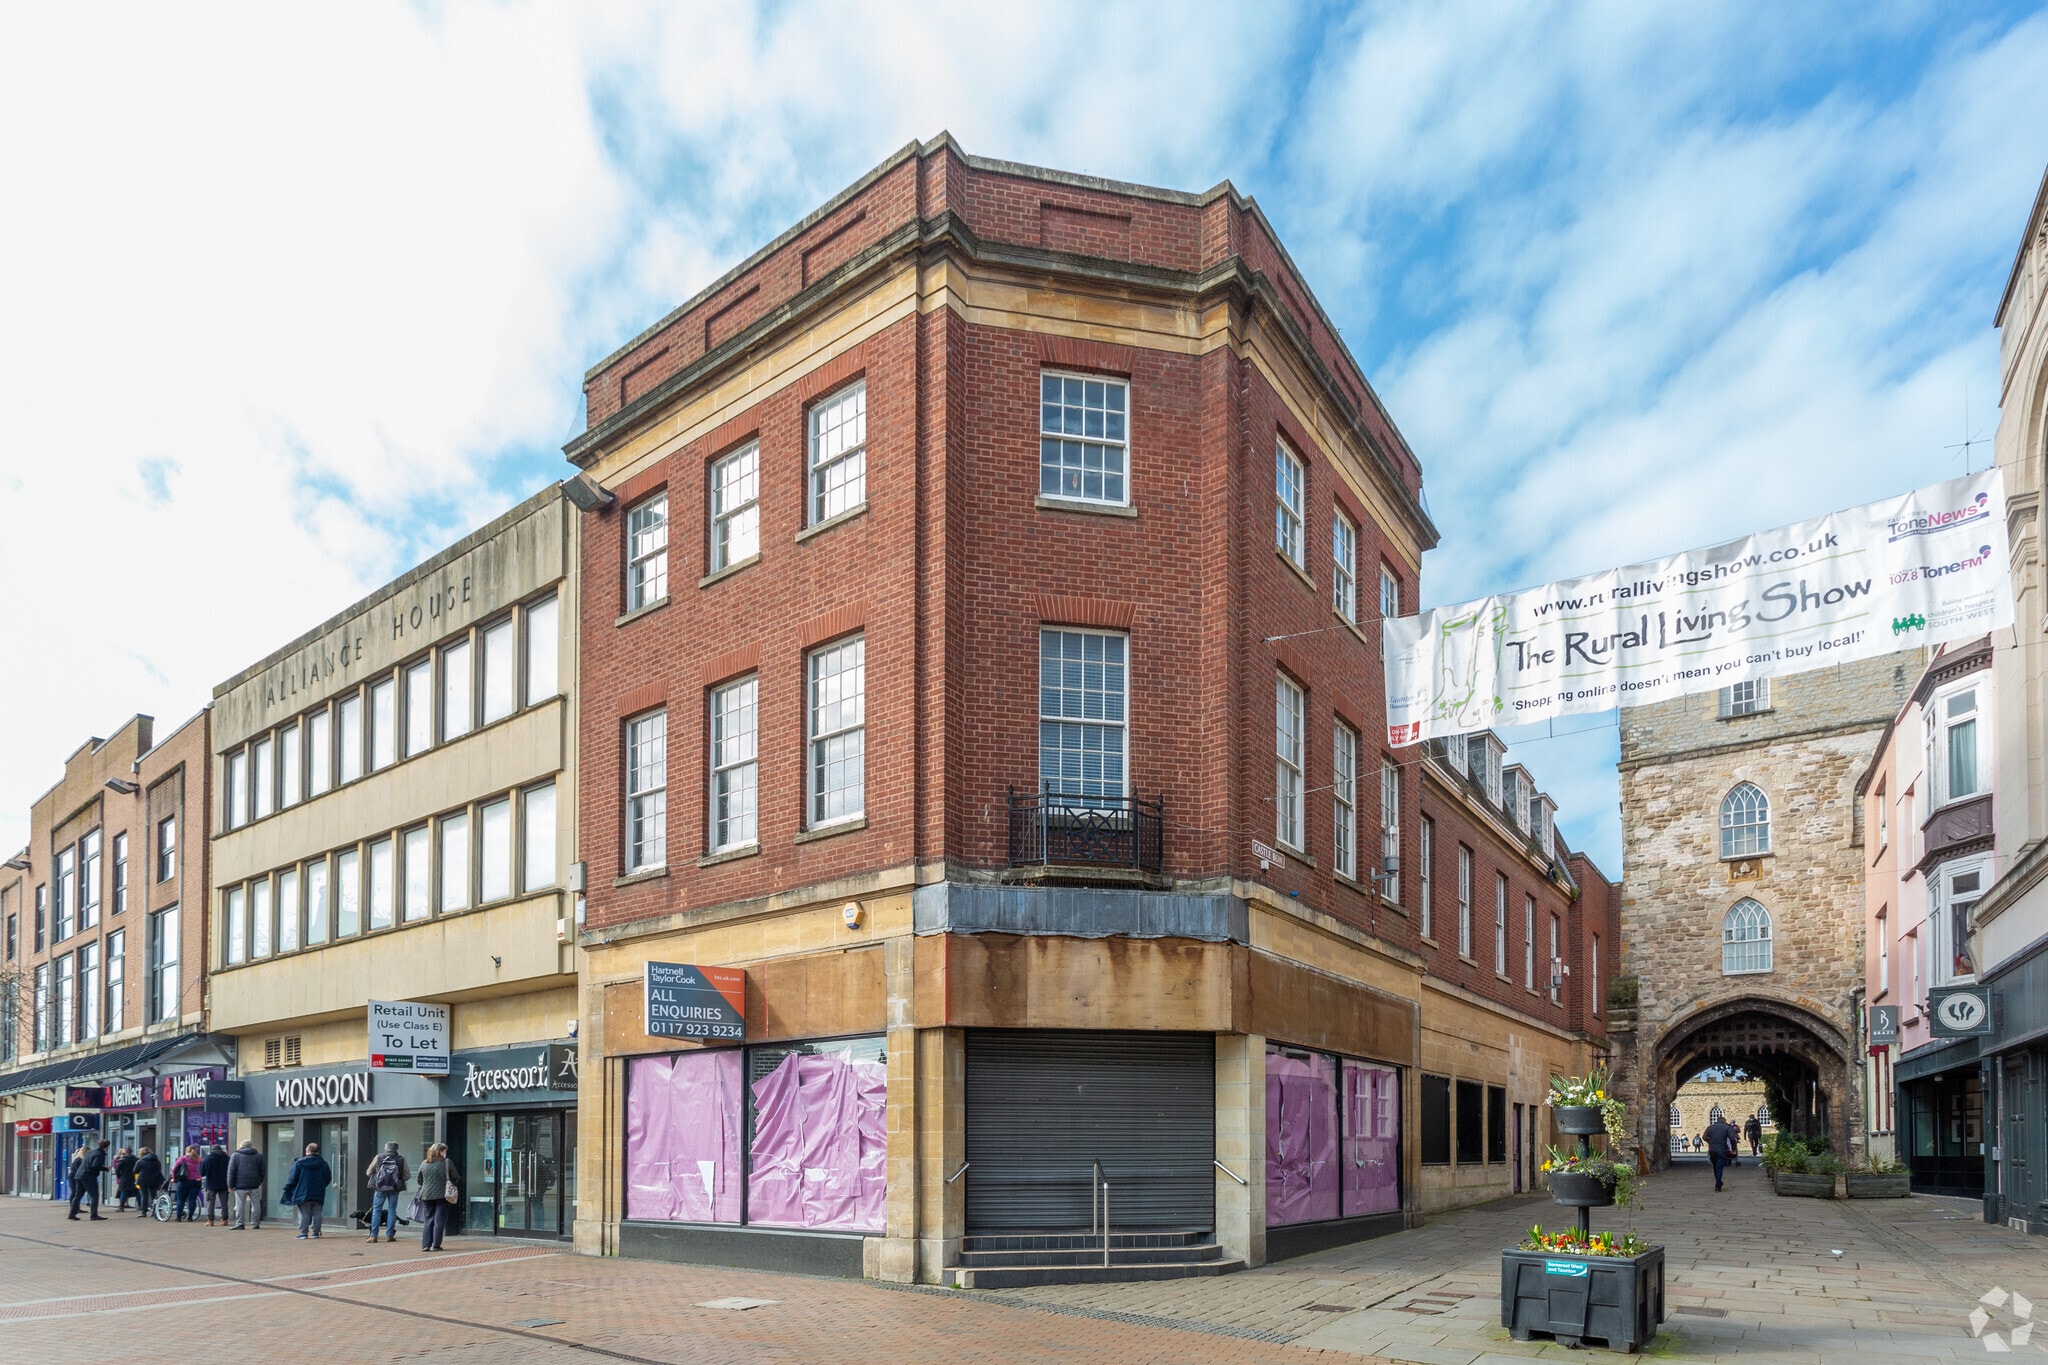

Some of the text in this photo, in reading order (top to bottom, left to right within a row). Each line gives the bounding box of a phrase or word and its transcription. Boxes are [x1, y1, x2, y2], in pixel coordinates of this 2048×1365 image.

[1888, 505, 1977, 535] ToneNews
[1533, 533, 1839, 617] www.rurallivngshow.co.uk
[1890, 571, 1918, 585] 107.8
[1965, 598, 1995, 610] hospice
[1506, 579, 1872, 671] The Rural Living Show
[1928, 607, 1995, 629] SOUTH WEST
[266, 577, 471, 708] ALLIANCE HOUSE
[1512, 691, 1574, 710] 'Shoppng
[1577, 684, 1617, 699] online
[1673, 667, 1711, 681] mean
[1715, 659, 1742, 675] you
[1746, 651, 1781, 664] can't
[1786, 644, 1813, 658] buy
[1254, 843, 1271, 860] CASTLE
[651, 965, 683, 976] Hartnell
[651, 989, 677, 1002] ALL
[374, 1004, 445, 1018] Retail Unit
[651, 1004, 722, 1020] ENQUIRIES
[377, 1020, 443, 1032] (Use Class E)
[651, 1021, 742, 1037] 0117 923 9234
[382, 1034, 438, 1050] To Let
[112, 1084, 142, 1107] NatWest
[275, 1072, 369, 1107] MONSOON
